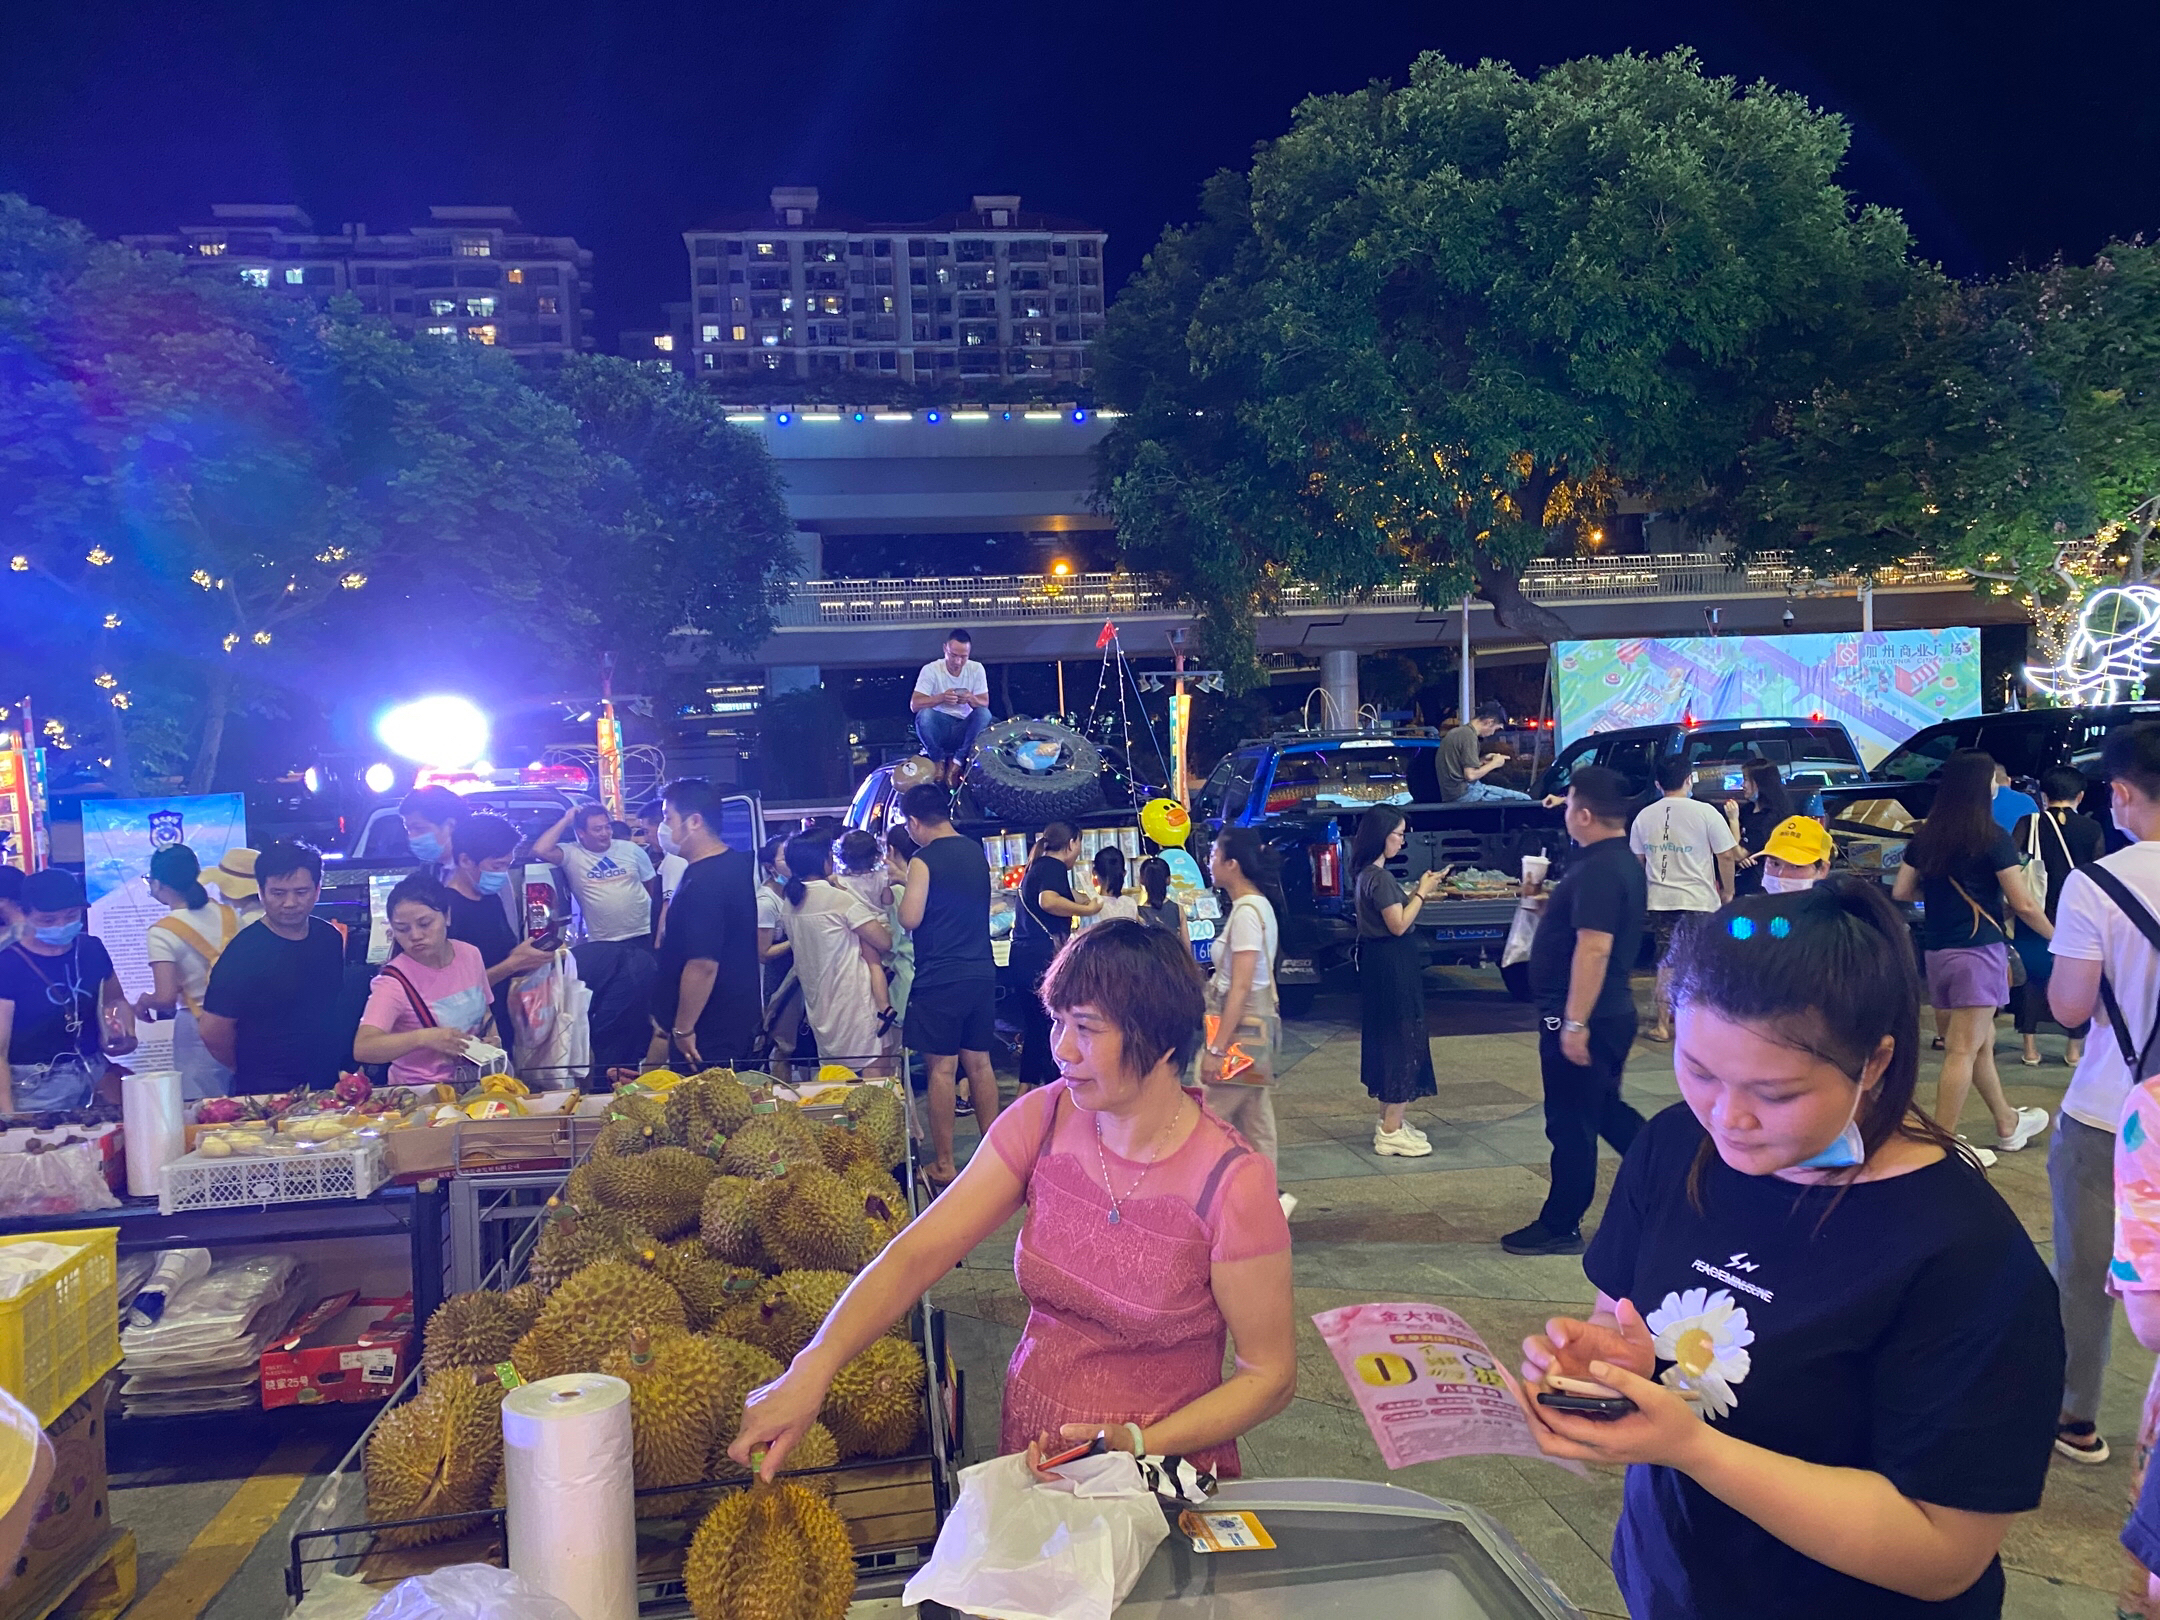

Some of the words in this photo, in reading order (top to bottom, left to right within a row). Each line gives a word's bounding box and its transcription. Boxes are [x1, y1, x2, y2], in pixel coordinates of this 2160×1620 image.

[1865, 643, 1962, 659] 加州商业广场
[1866, 658, 1911, 666] CALIFORNIA
[587, 868, 627, 879] adidas
[46, 964, 92, 1005] CK
